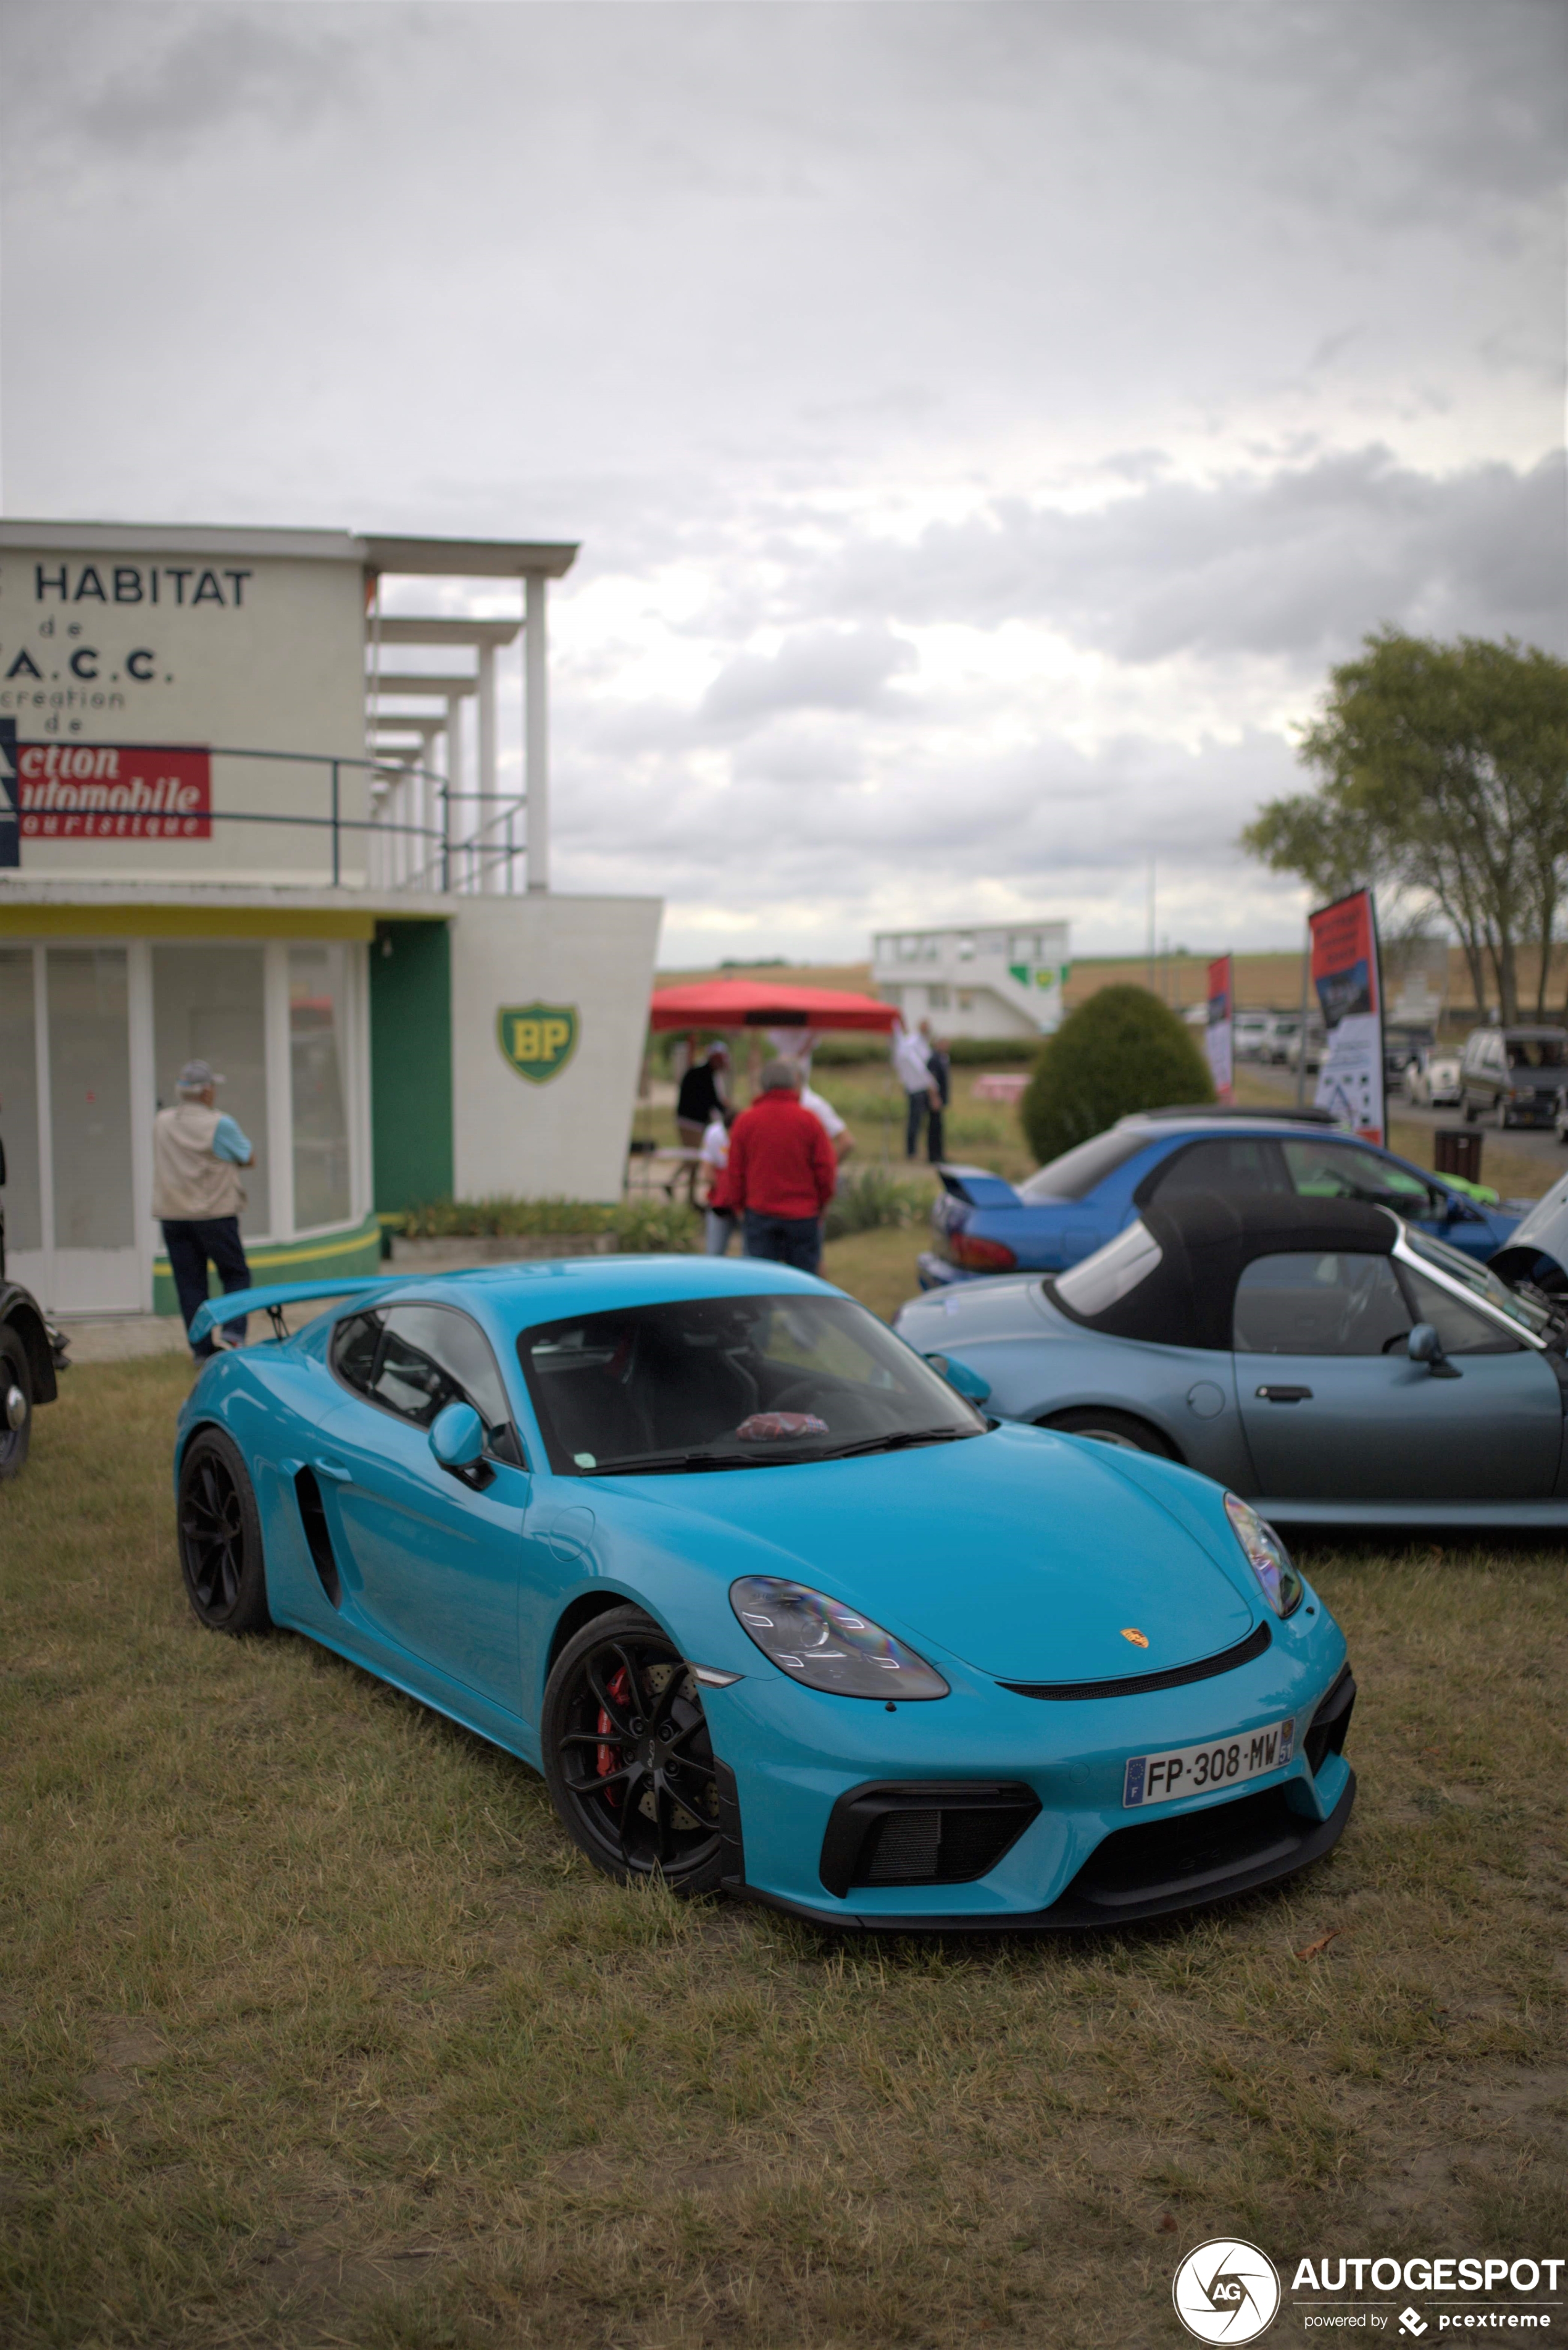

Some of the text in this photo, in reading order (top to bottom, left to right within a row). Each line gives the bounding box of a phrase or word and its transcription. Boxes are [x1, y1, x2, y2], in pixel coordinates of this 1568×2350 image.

[35, 564, 252, 606] HABITAT
[39, 615, 82, 638] de
[0, 645, 174, 682] A.C.C.
[44, 711, 82, 734] de
[0, 812, 199, 836] ouristique
[514, 1019, 569, 1061] BP
[1131, 1731, 1291, 1798] F FP-308-MW 51
